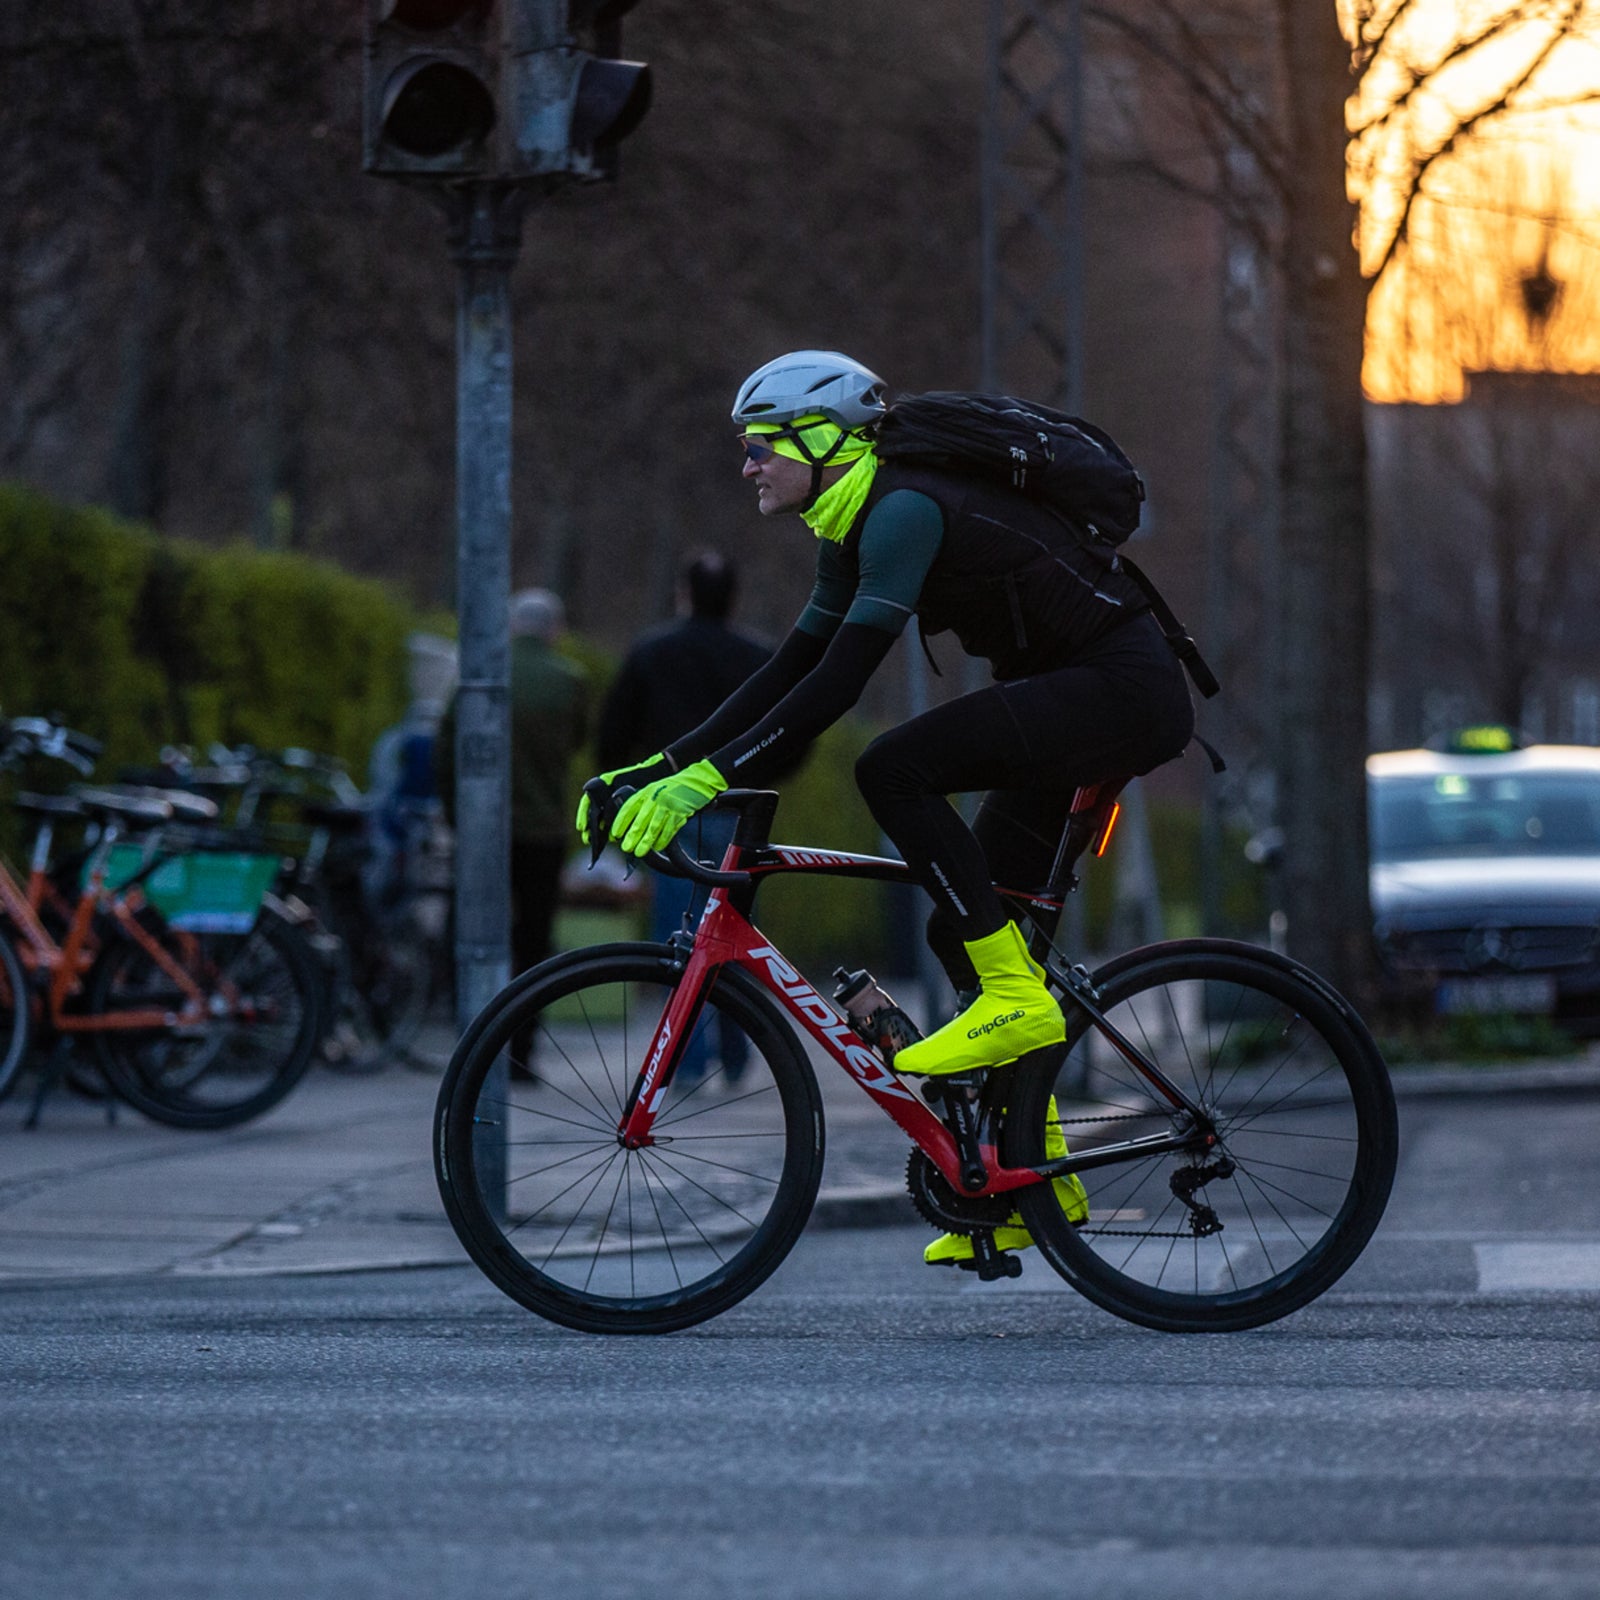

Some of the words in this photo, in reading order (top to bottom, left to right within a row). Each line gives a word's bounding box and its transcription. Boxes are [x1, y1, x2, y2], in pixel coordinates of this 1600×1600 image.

[638, 1018, 671, 1105] RIDLEY
[747, 947, 917, 1102] RIDLEY
[967, 1009, 1026, 1040] GripGrab
